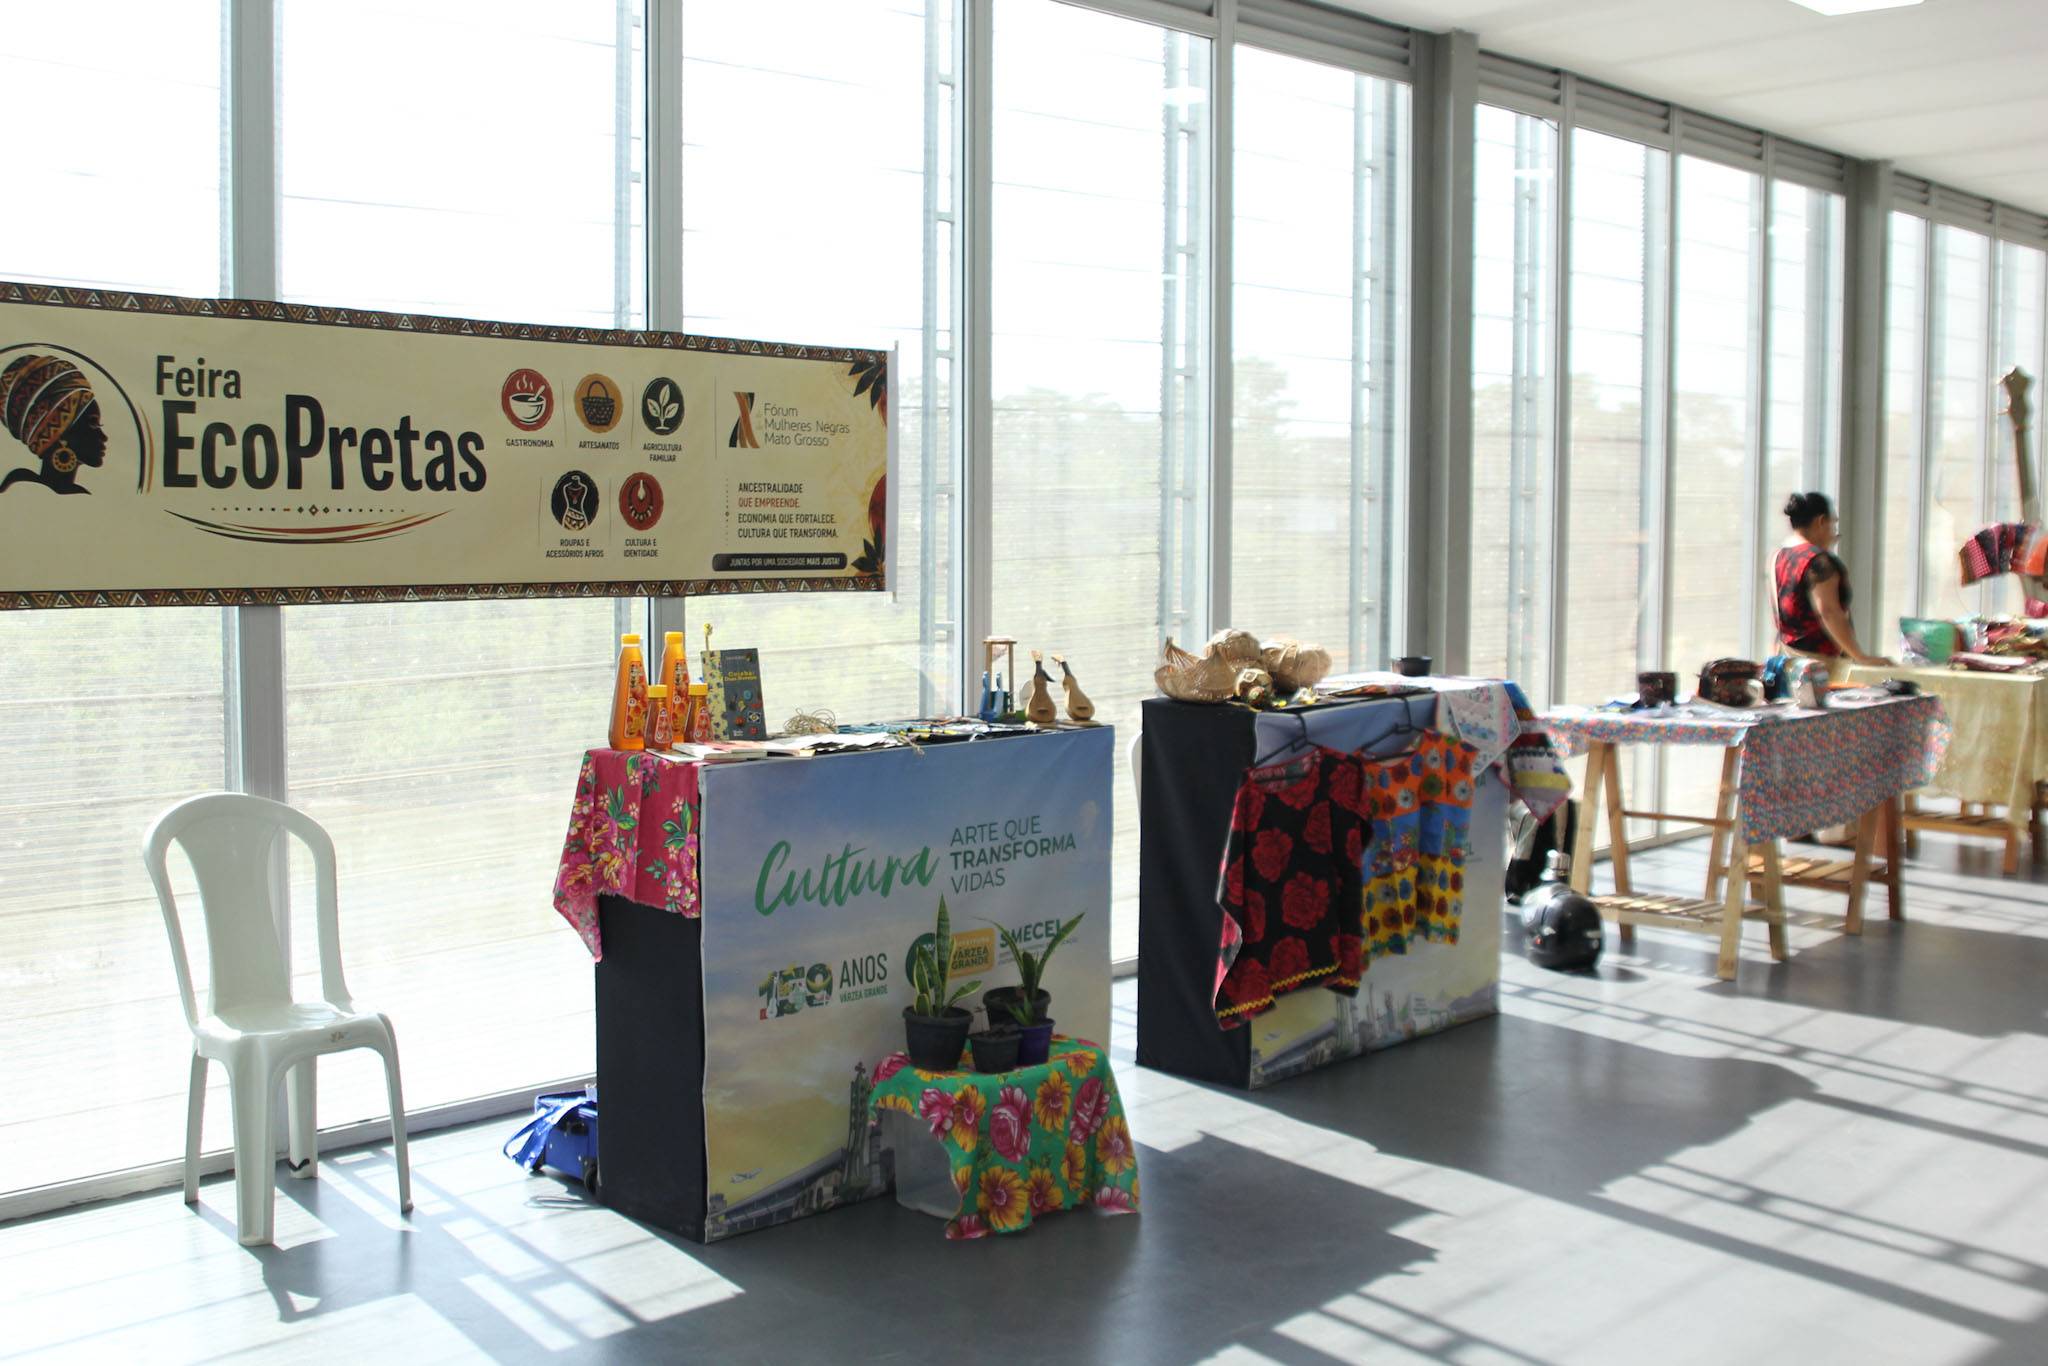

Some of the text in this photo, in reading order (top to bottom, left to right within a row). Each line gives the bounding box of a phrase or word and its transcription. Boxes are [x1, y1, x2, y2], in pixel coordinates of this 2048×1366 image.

[156, 355, 241, 399] Feira
[764, 402, 798, 417] Fórum
[764, 418, 812, 432] Mulheres
[816, 421, 850, 436] Negras
[162, 394, 487, 492] EcoPretas
[506, 438, 554, 448] GASTRONOMIA
[578, 441, 620, 450] ARTESANATOS
[764, 433, 829, 447] Mato Grosso
[643, 443, 682, 452] AGRICULTURA
[649, 454, 676, 462] FAMILIAR
[738, 482, 803, 494] ANCESTRALIDADE
[738, 497, 801, 508] QUE EMPREENDE.
[738, 513, 837, 524] ECONOMIA QUE FORTALECE.
[738, 528, 839, 539] CULTURA QUE TRANSFORMA.
[560, 538, 585, 547] ROUPAS
[625, 538, 652, 547] CULTURA
[546, 548, 604, 558] ACESSÓRIOS AFROS
[624, 549, 658, 558] IDENTIDADE
[950, 815, 1041, 848] ARTE QUE
[950, 833, 1077, 871] TRANSFORMA
[754, 840, 941, 917] Cultura
[951, 867, 1006, 895] VIDAS
[951, 956, 988, 970] GRANDE
[839, 953, 888, 989] ANOS
[839, 984, 888, 1003] VÁRZEA GRANDE
